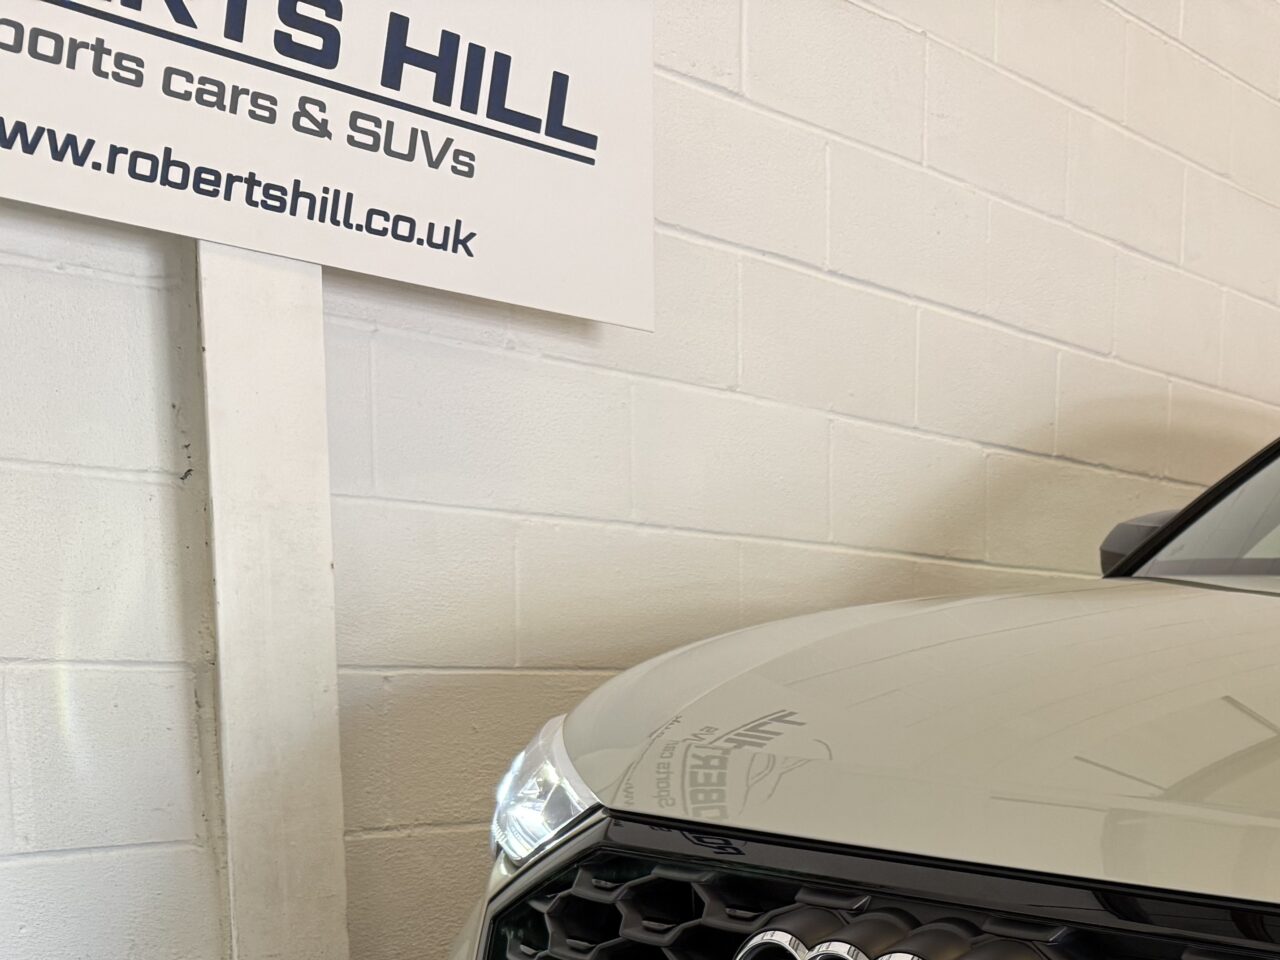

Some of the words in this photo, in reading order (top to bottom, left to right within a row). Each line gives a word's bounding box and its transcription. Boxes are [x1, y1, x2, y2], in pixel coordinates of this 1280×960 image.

[162, 66, 278, 125] cars
[291, 97, 332, 141] &
[346, 110, 476, 179] SUVs
[381, 11, 598, 150] HILL
